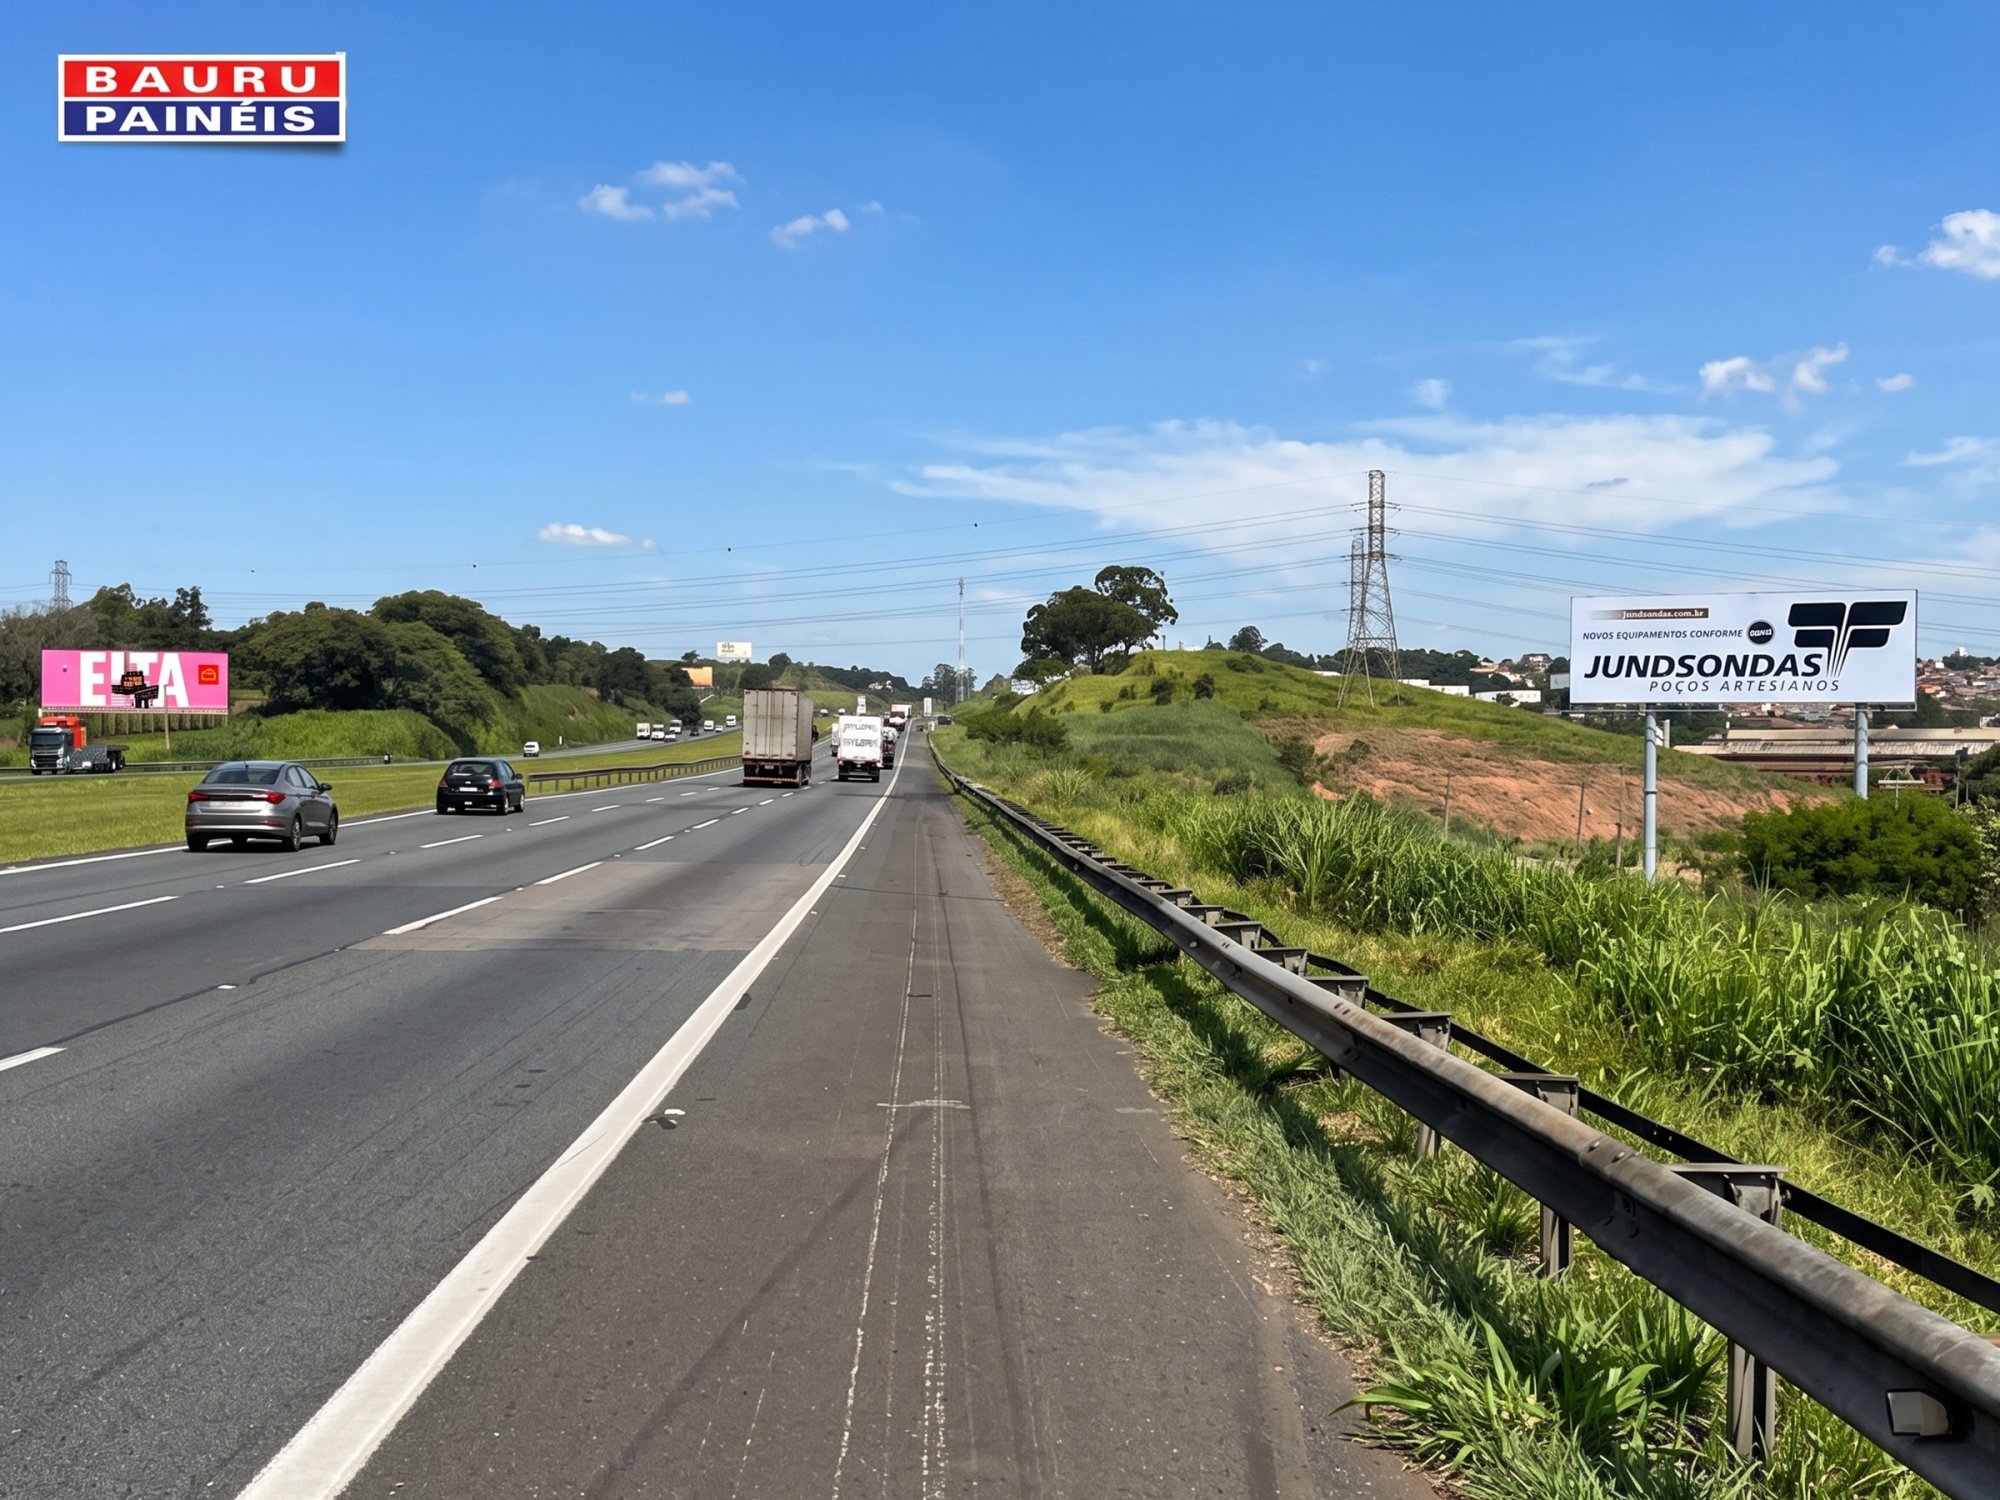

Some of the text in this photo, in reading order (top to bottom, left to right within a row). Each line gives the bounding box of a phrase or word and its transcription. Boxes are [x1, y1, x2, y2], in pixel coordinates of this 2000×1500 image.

[1582, 632, 1614, 640] NOVOS
[1616, 629, 1688, 640] EQUIPAMENTOS
[1690, 629, 1743, 638] CONFORME
[1584, 653, 1823, 679] JUNDSONDAS
[1649, 679, 1840, 695] POÇOS ARTESIANOS
